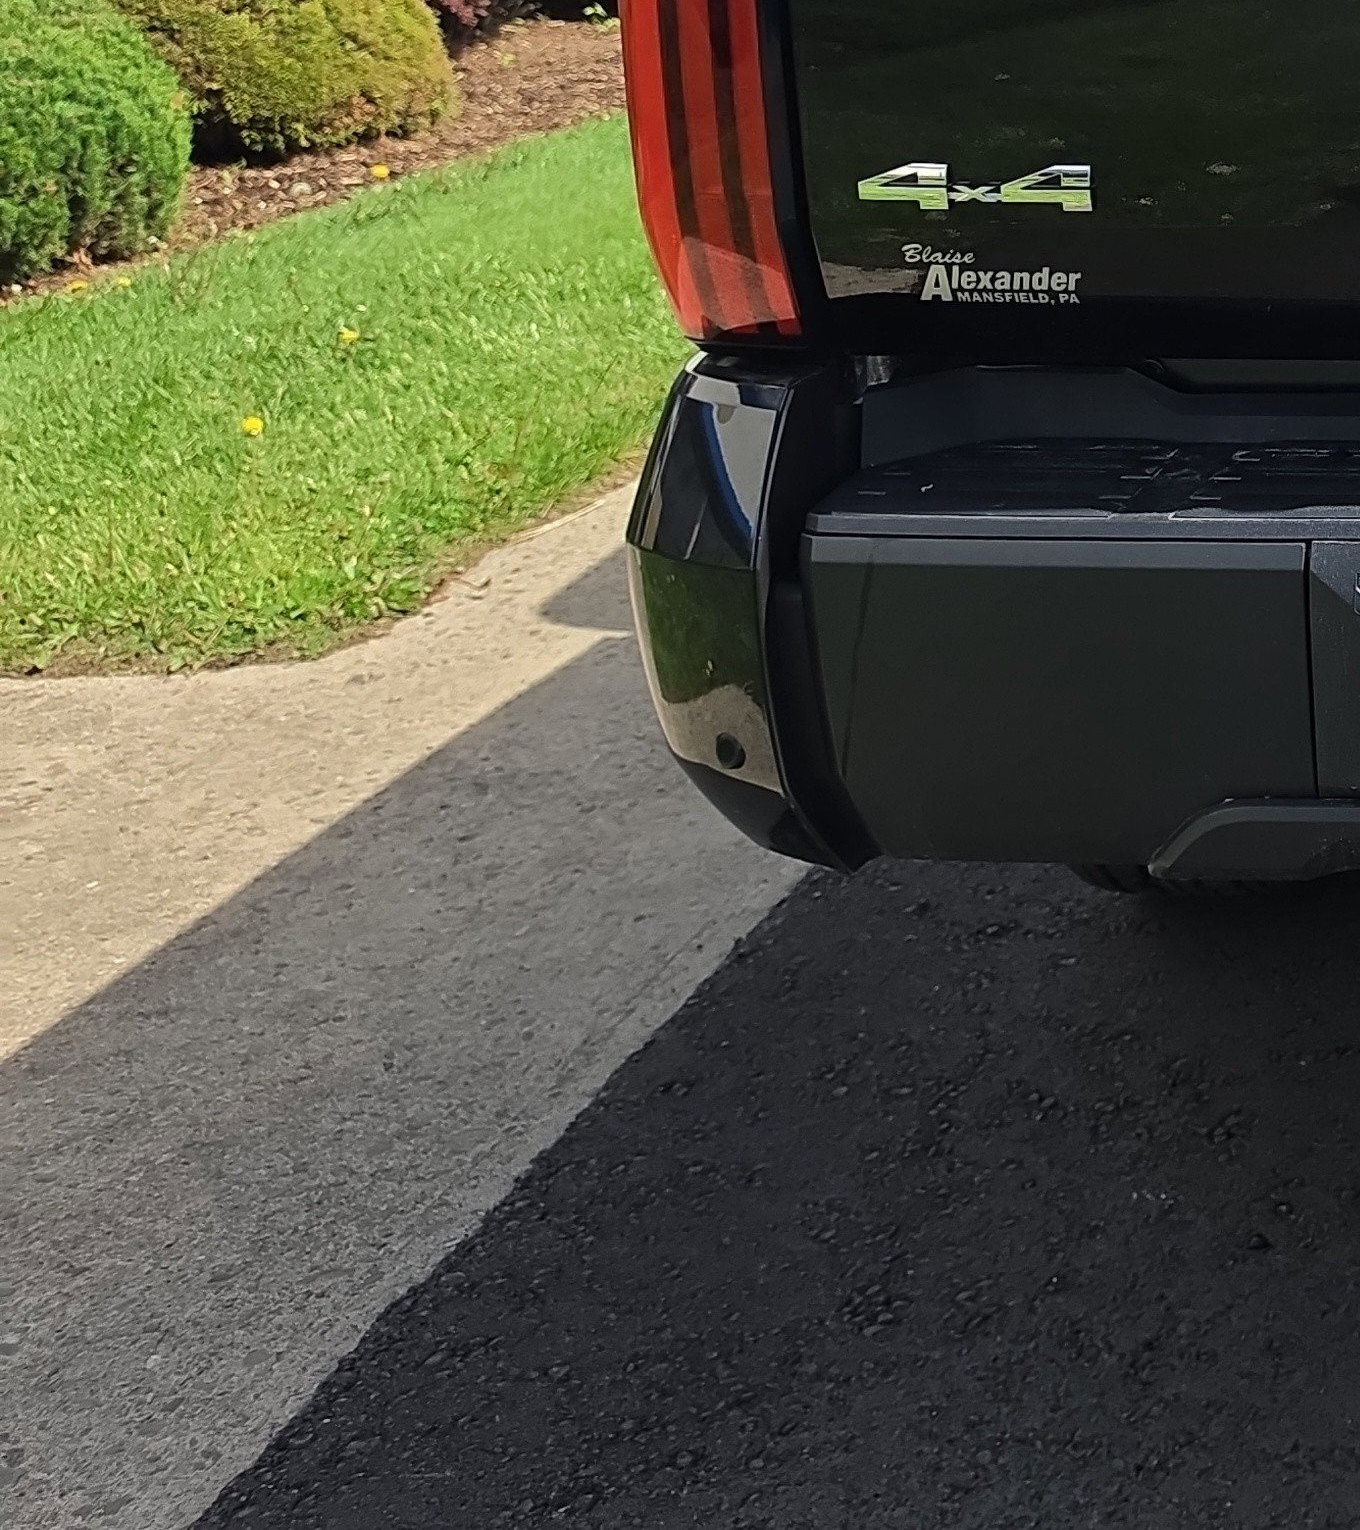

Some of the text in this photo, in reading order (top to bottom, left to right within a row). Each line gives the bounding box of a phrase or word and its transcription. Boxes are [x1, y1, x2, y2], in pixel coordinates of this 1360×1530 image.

[901, 243, 976, 264] Blaise
[919, 264, 1082, 302] Alexander
[956, 291, 1081, 306] MANSFIELD, PA
